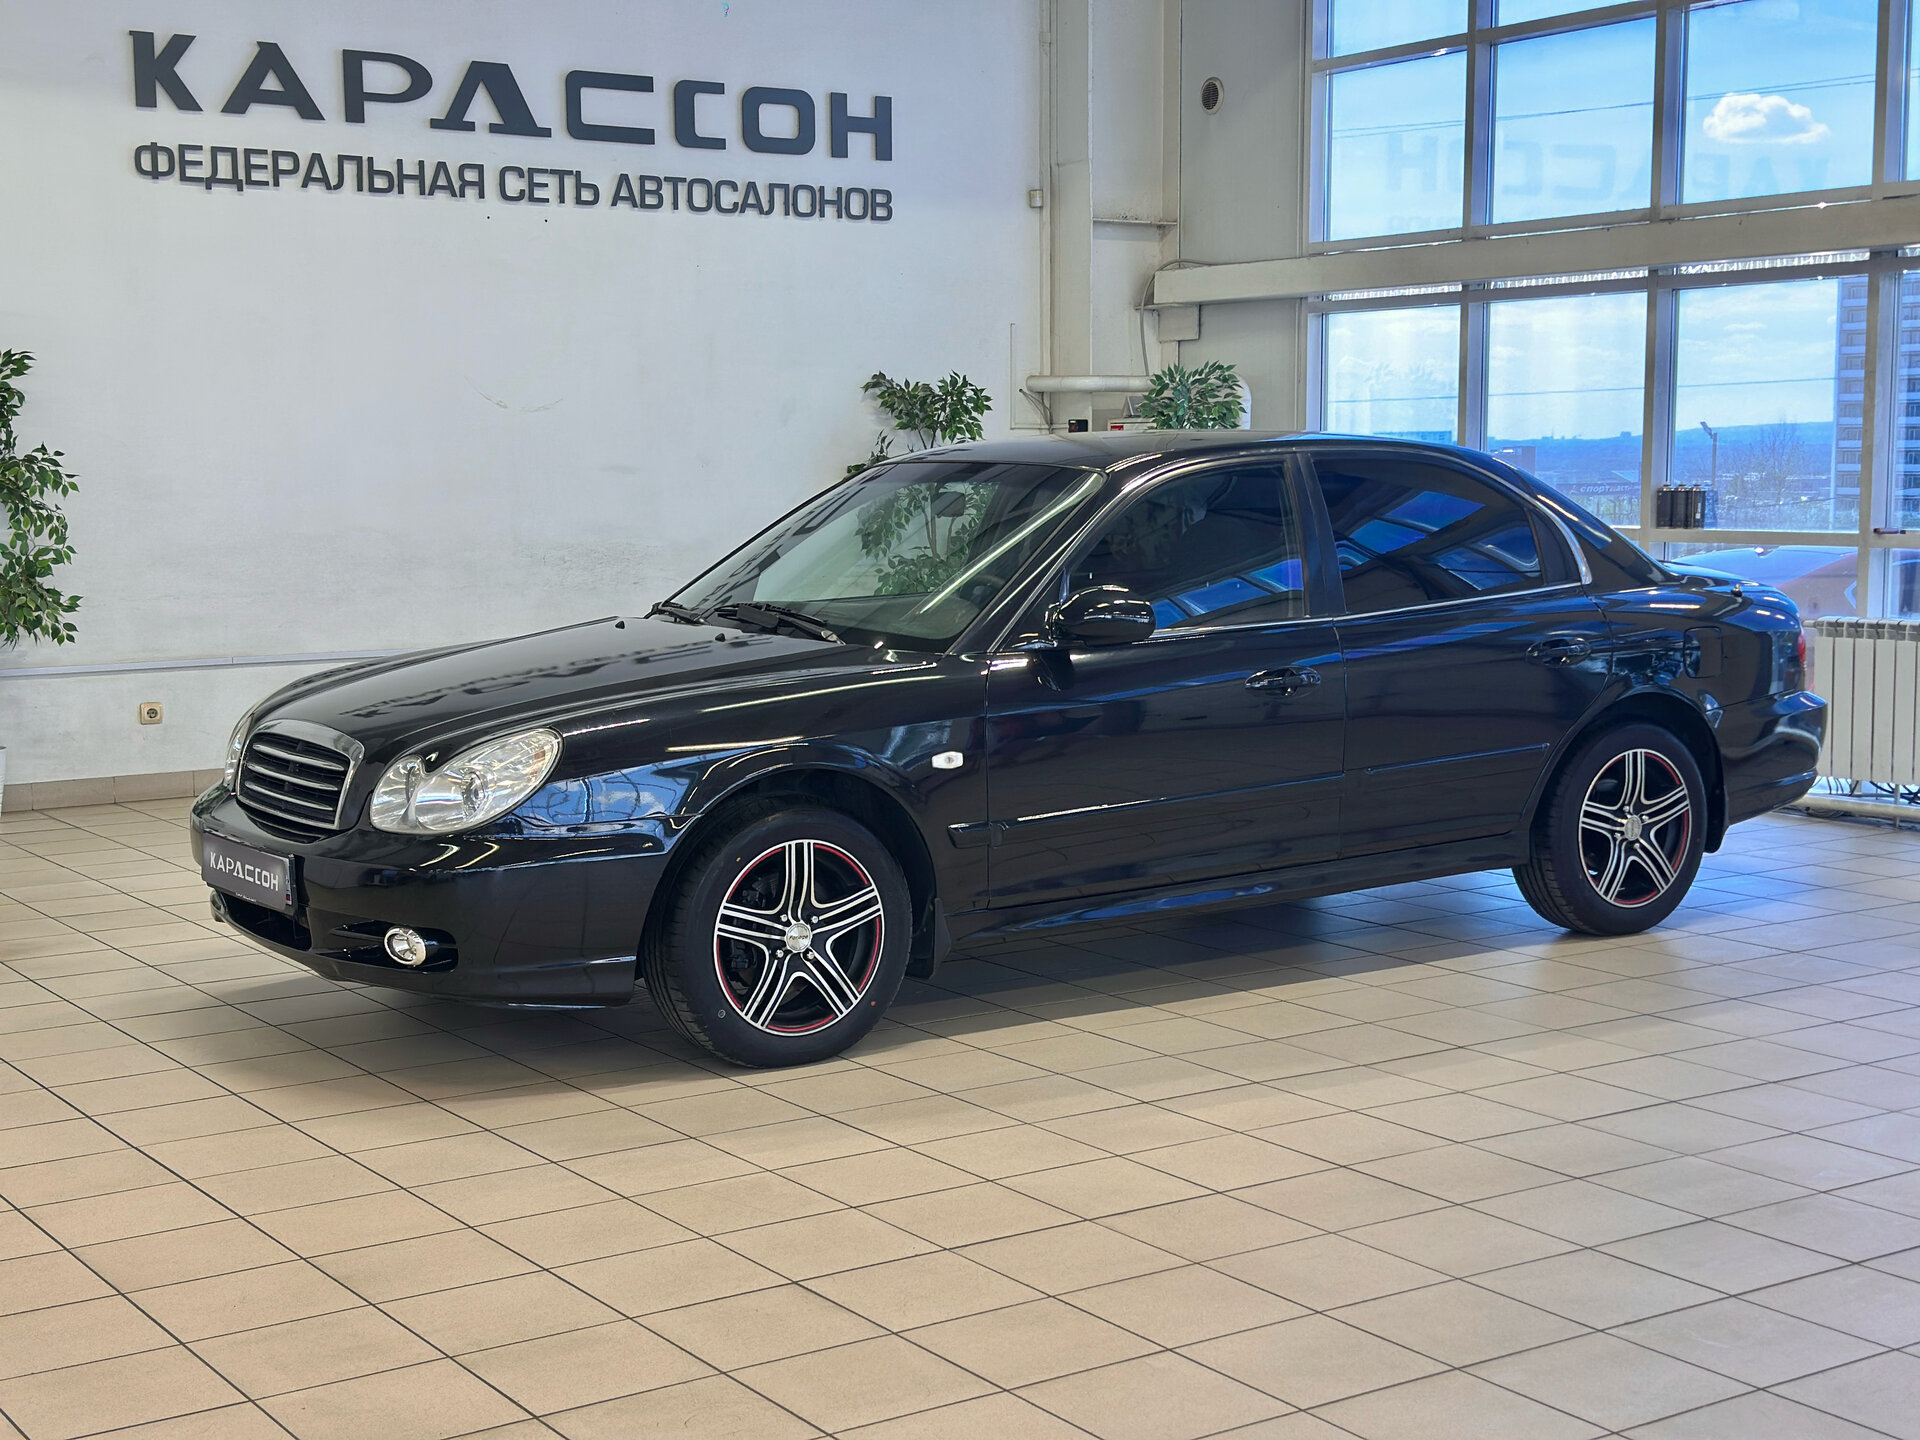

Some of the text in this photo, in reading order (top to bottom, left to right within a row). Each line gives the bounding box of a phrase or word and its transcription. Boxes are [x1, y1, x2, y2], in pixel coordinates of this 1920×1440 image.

[134, 141, 893, 222] ФЕДЕРАЛЬНАЯ СЕТЬ АВТОСАЛОНОВ
